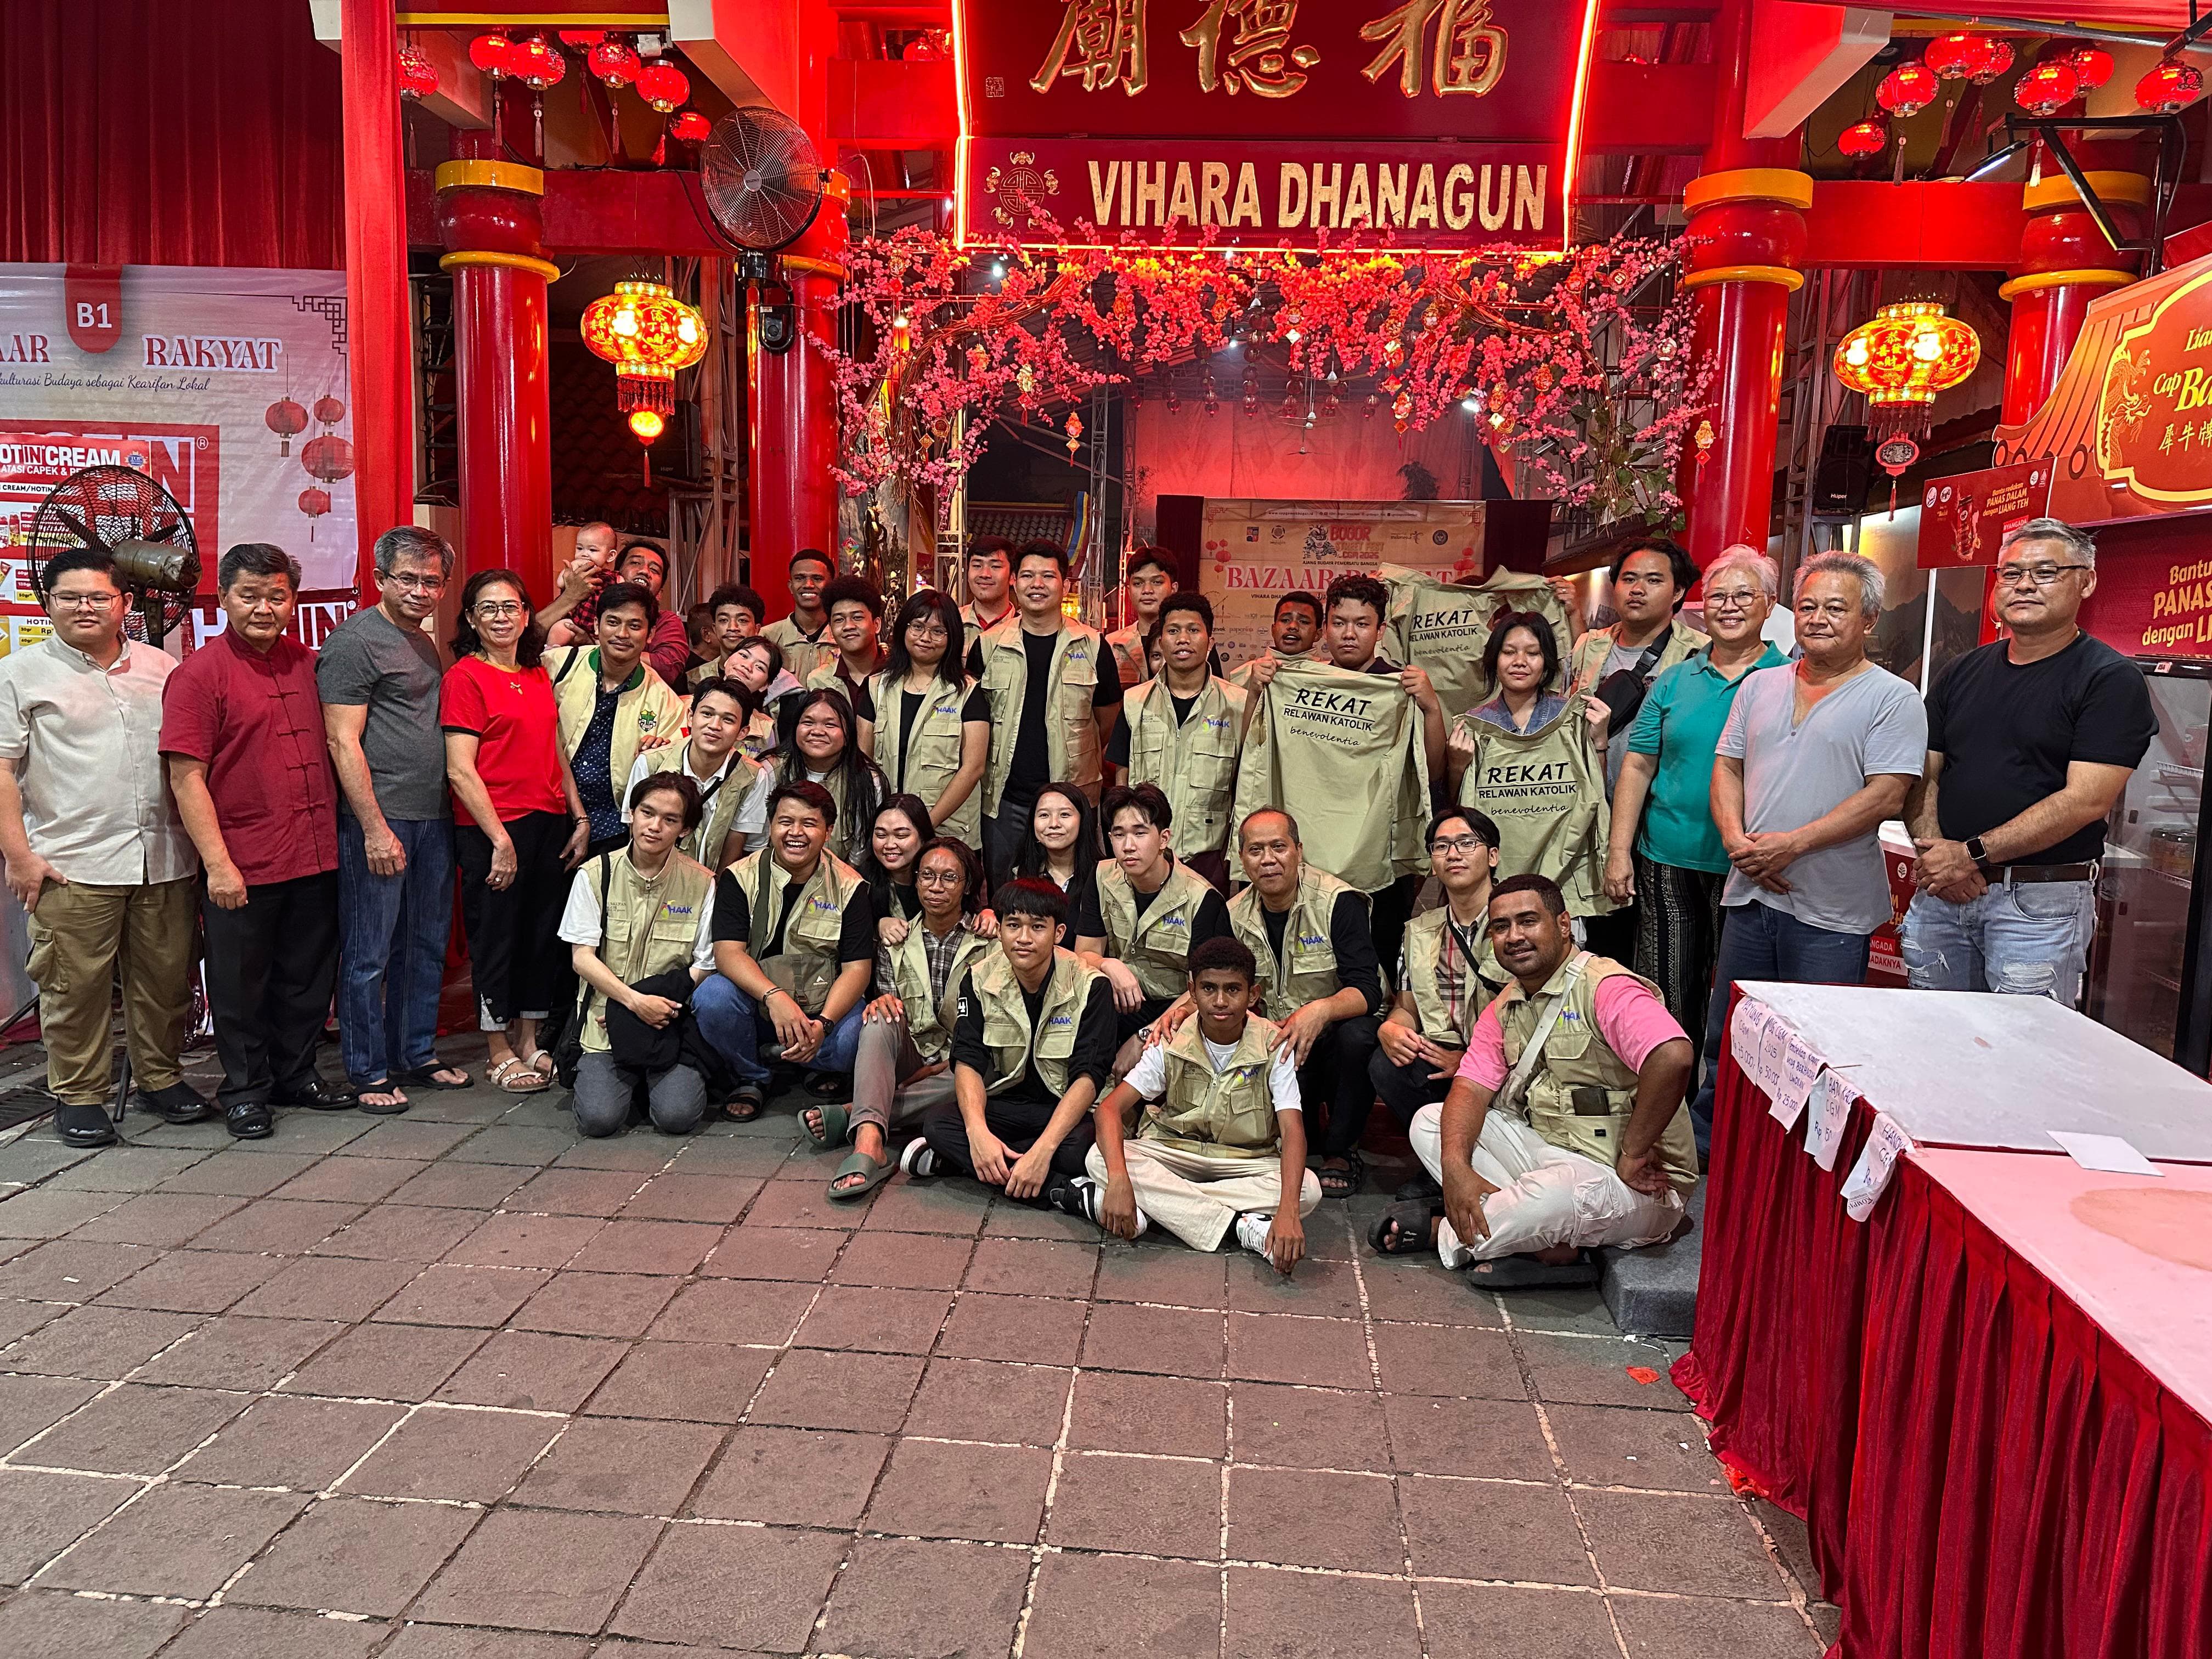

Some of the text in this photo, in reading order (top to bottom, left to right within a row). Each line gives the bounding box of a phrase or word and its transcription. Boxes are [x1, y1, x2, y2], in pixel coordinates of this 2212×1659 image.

[1088, 160, 1547, 232] VIHARA DHANAGUN
[77, 303, 112, 329] B1
[145, 337, 280, 370] RAKYAT
[44, 373, 83, 390] Budaya
[86, 375, 124, 390] sebagai
[128, 375, 174, 392] Kearifan
[177, 377, 211, 390] Lokal
[2153, 372, 2182, 398] Cap
[46, 446, 121, 467] CREAM
[27, 466, 58, 476] CAPEK
[60, 467, 67, 476] &
[1987, 487, 2027, 508] PANAS DALAM
[1998, 501, 2016, 515] LIANG
[2017, 496, 2029, 510] TEH
[1330, 525, 1372, 541] BOGOR
[1335, 541, 1385, 551] STREET FEST
[1227, 567, 1333, 590] BAZAAR
[1412, 609, 1474, 630] REKAT
[1440, 627, 1479, 639] KATOLIK
[2142, 622, 2194, 647] dengan
[1295, 688, 1372, 716] REKAT
[1284, 707, 1373, 732] RELAWAN KATOLIK
[1290, 726, 1361, 747] benevolentia
[1487, 762, 1569, 785] REKAT
[1479, 785, 1577, 799] RELAWAN KATOLIK
[1491, 804, 1568, 816] benevolentia
[1869, 955, 1901, 970] ADAKNYA
[1742, 998, 1763, 1027] PAYUNG
[1739, 1019, 1750, 1039] CGM
[1764, 1041, 1778, 1058] 2025
[1829, 1077, 1842, 1098] BAJU
[1826, 1099, 1840, 1120] CGM
[1814, 1120, 1822, 1141] Rp
